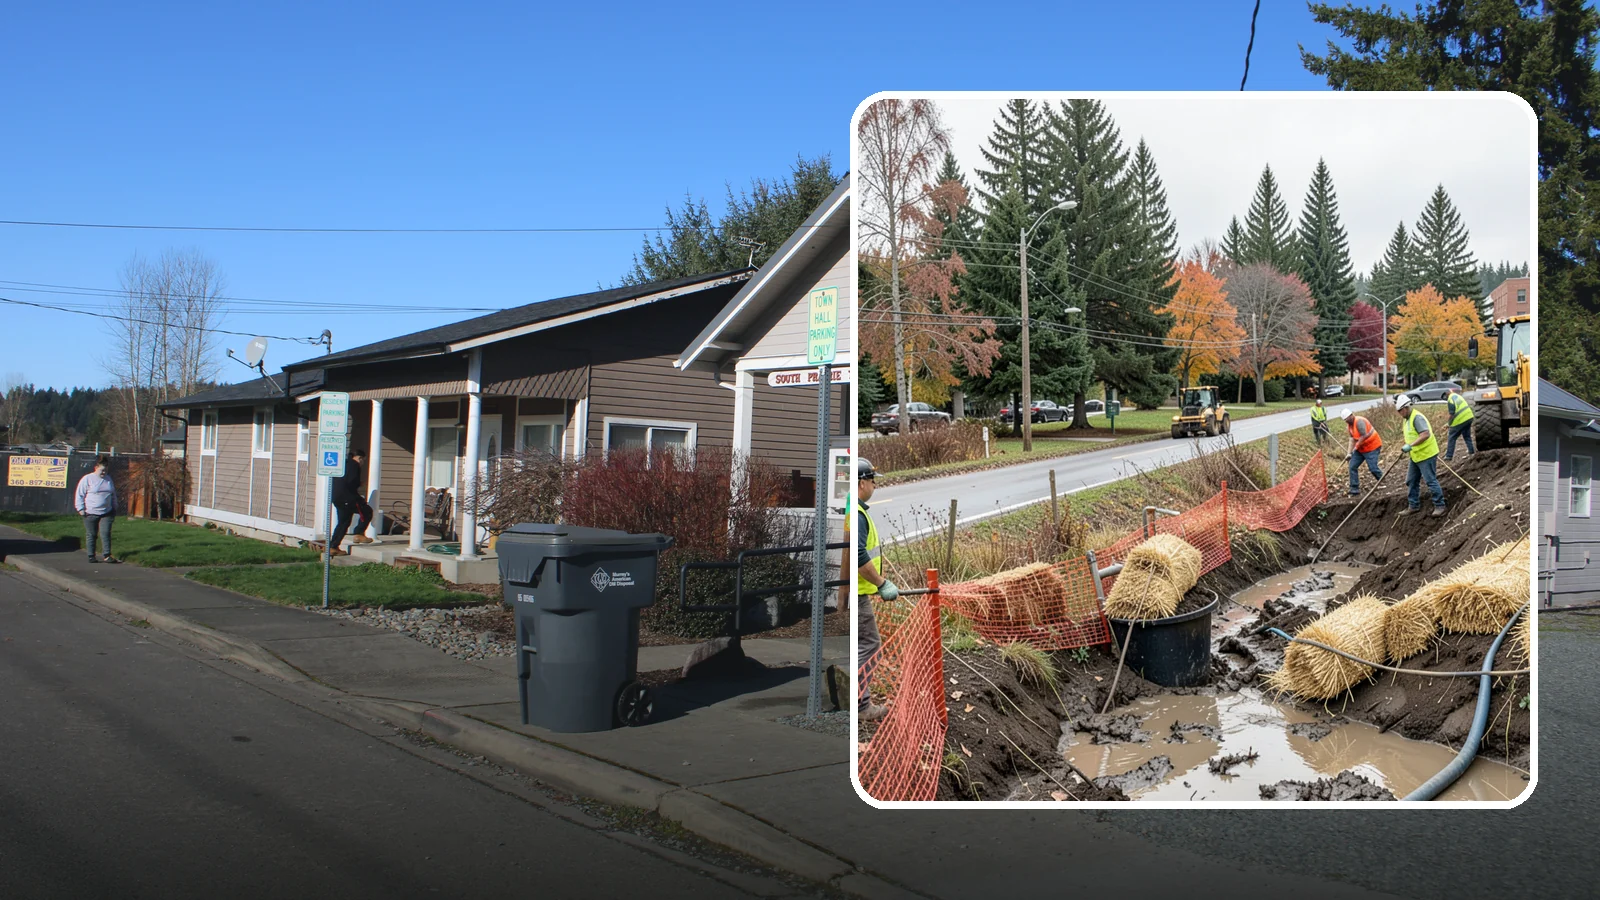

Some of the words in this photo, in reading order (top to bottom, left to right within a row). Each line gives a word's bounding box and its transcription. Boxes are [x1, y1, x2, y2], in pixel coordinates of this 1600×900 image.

[815, 295, 833, 307] TOWN
[814, 311, 831, 324] HALL
[810, 327, 835, 340] PARKING
[813, 344, 831, 357] ONLY
[775, 373, 801, 384] SOUTH
[808, 370, 842, 382] PRIE
